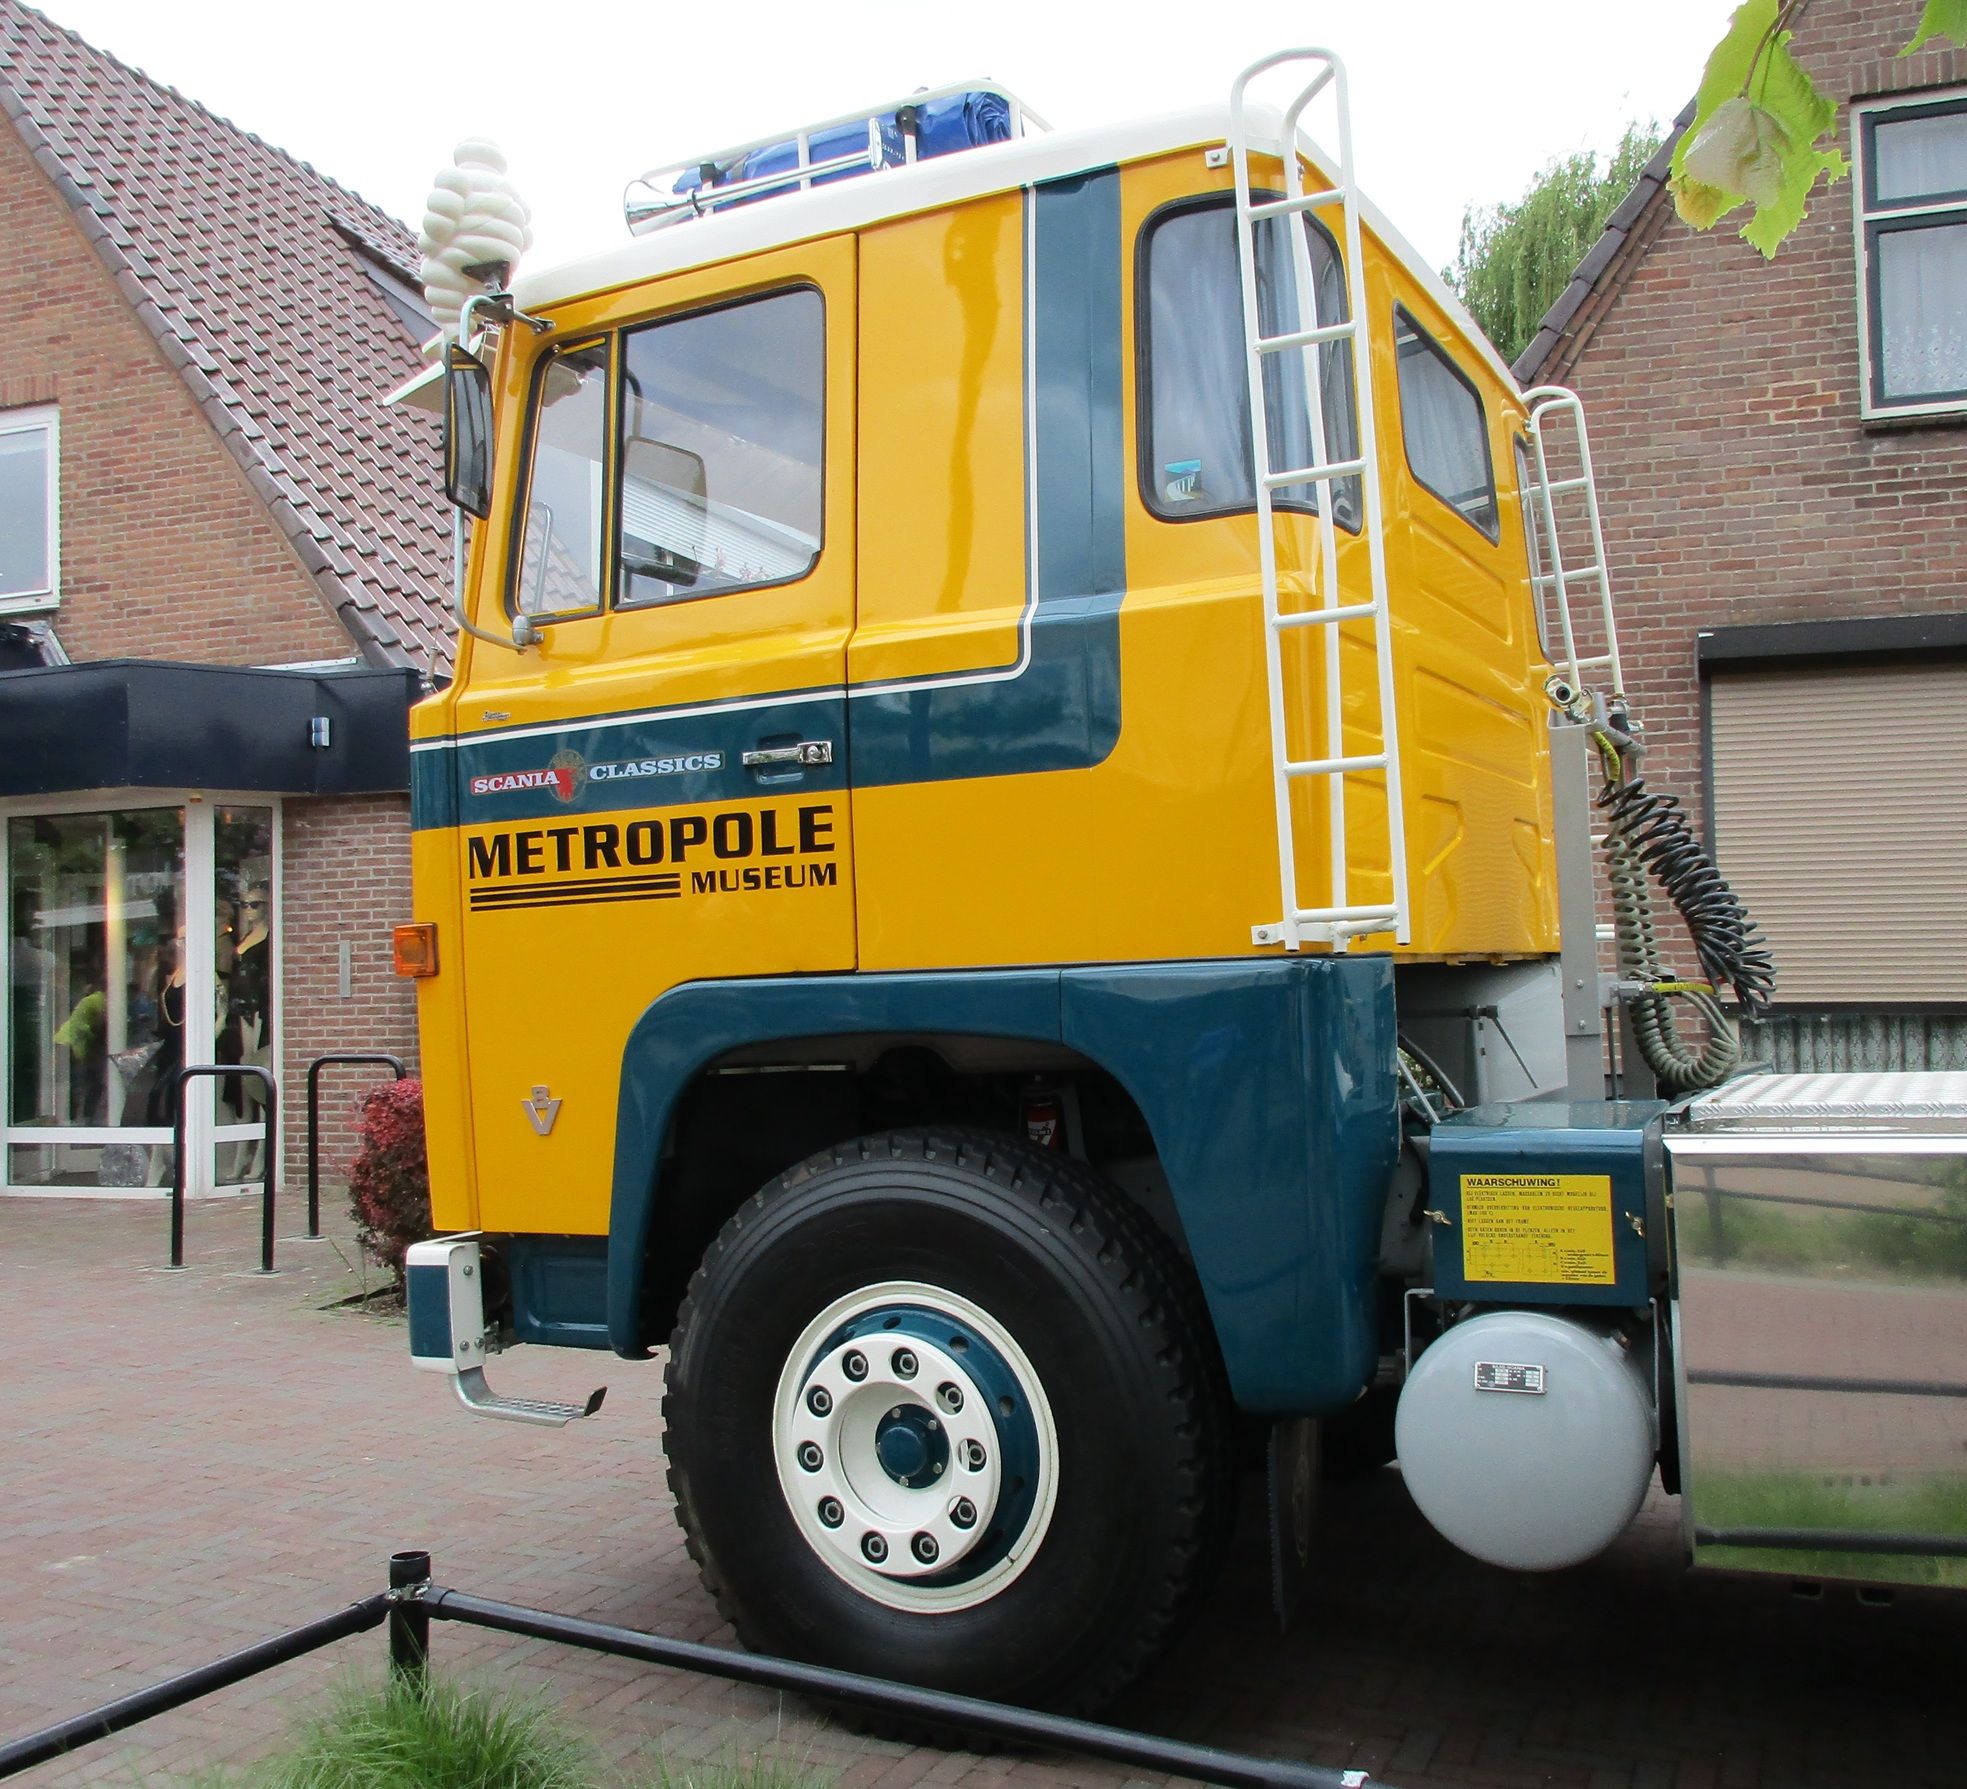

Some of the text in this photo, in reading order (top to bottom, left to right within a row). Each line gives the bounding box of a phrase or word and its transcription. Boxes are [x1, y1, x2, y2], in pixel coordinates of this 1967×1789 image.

[474, 753, 721, 793] SCANIA CLASSICS
[468, 805, 835, 879] METROPOLE
[692, 862, 837, 894] MUSEUM
[1466, 1177, 1560, 1188] WAARSCHUWING!
